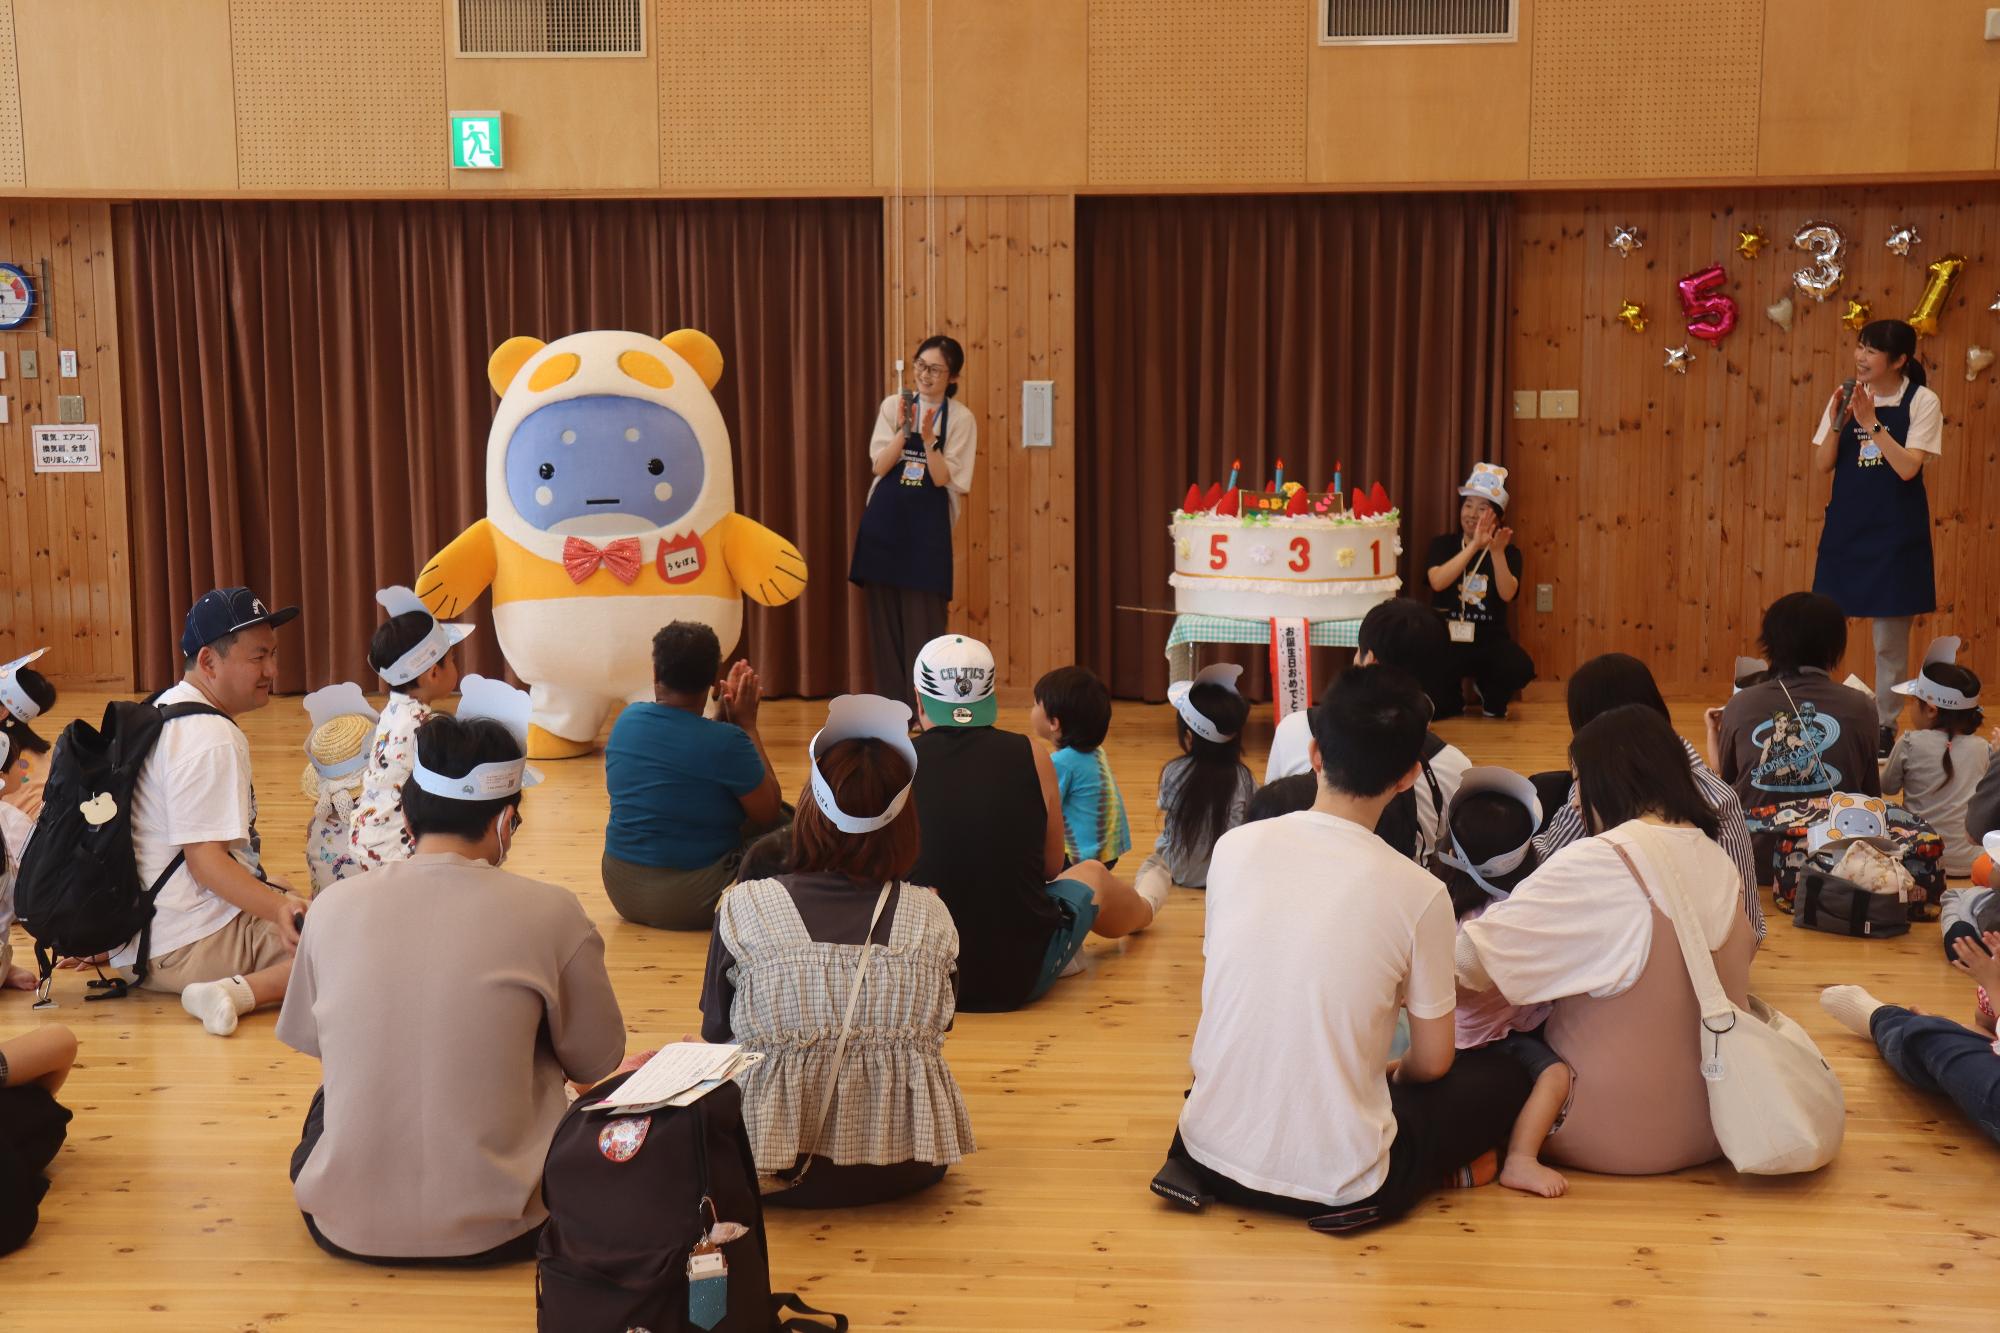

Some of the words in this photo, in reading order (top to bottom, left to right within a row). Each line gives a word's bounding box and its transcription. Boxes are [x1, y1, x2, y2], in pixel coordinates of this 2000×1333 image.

[1680, 264, 1737, 344] 5
[1793, 220, 1846, 301] 3
[1909, 257, 1966, 337] 1
[1210, 534, 1228, 570] 5
[1288, 537, 1311, 573] 3
[1370, 539, 1381, 576] 1
[940, 667, 985, 680] CELTICS
